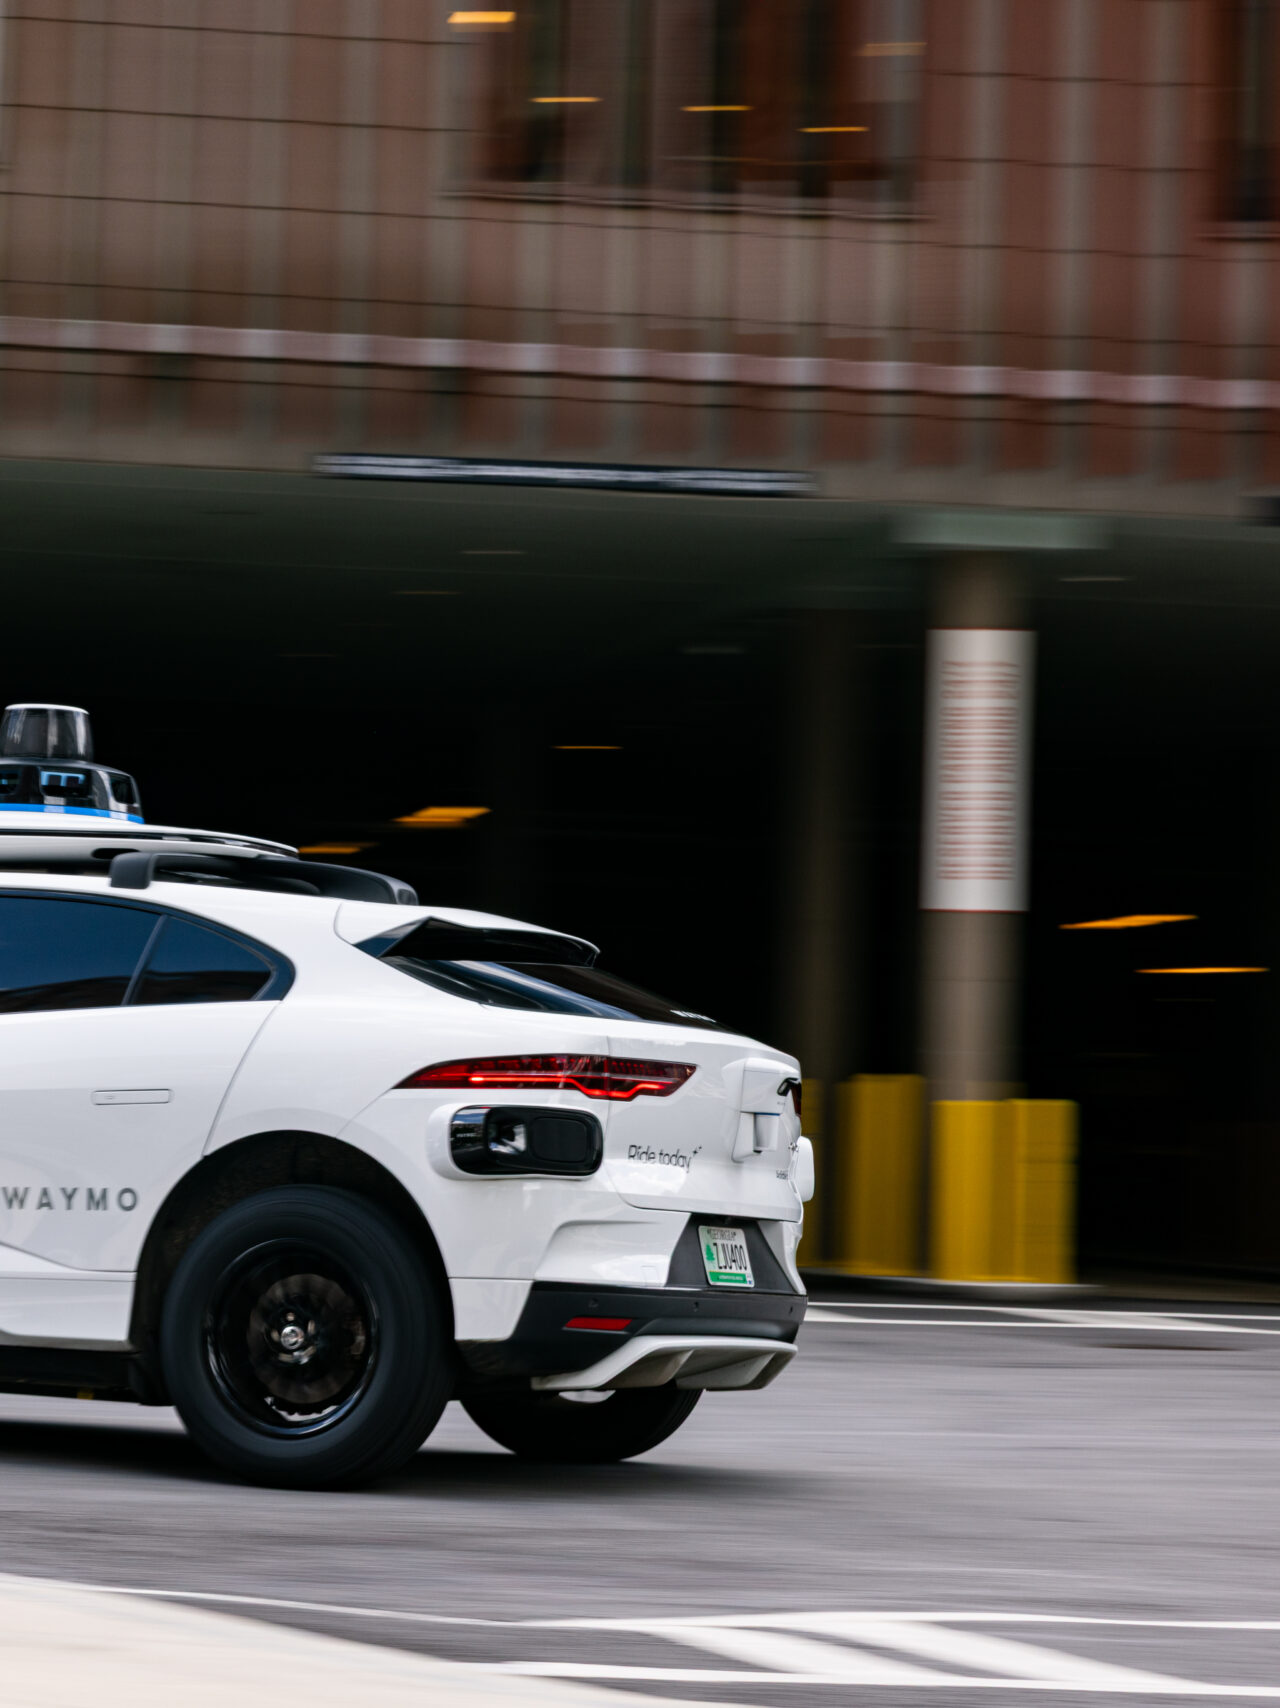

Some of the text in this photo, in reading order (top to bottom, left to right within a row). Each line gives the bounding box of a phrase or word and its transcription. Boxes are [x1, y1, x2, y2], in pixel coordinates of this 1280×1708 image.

[628, 1144, 692, 1174] Ride today
[0, 1186, 138, 1211] WAYMO
